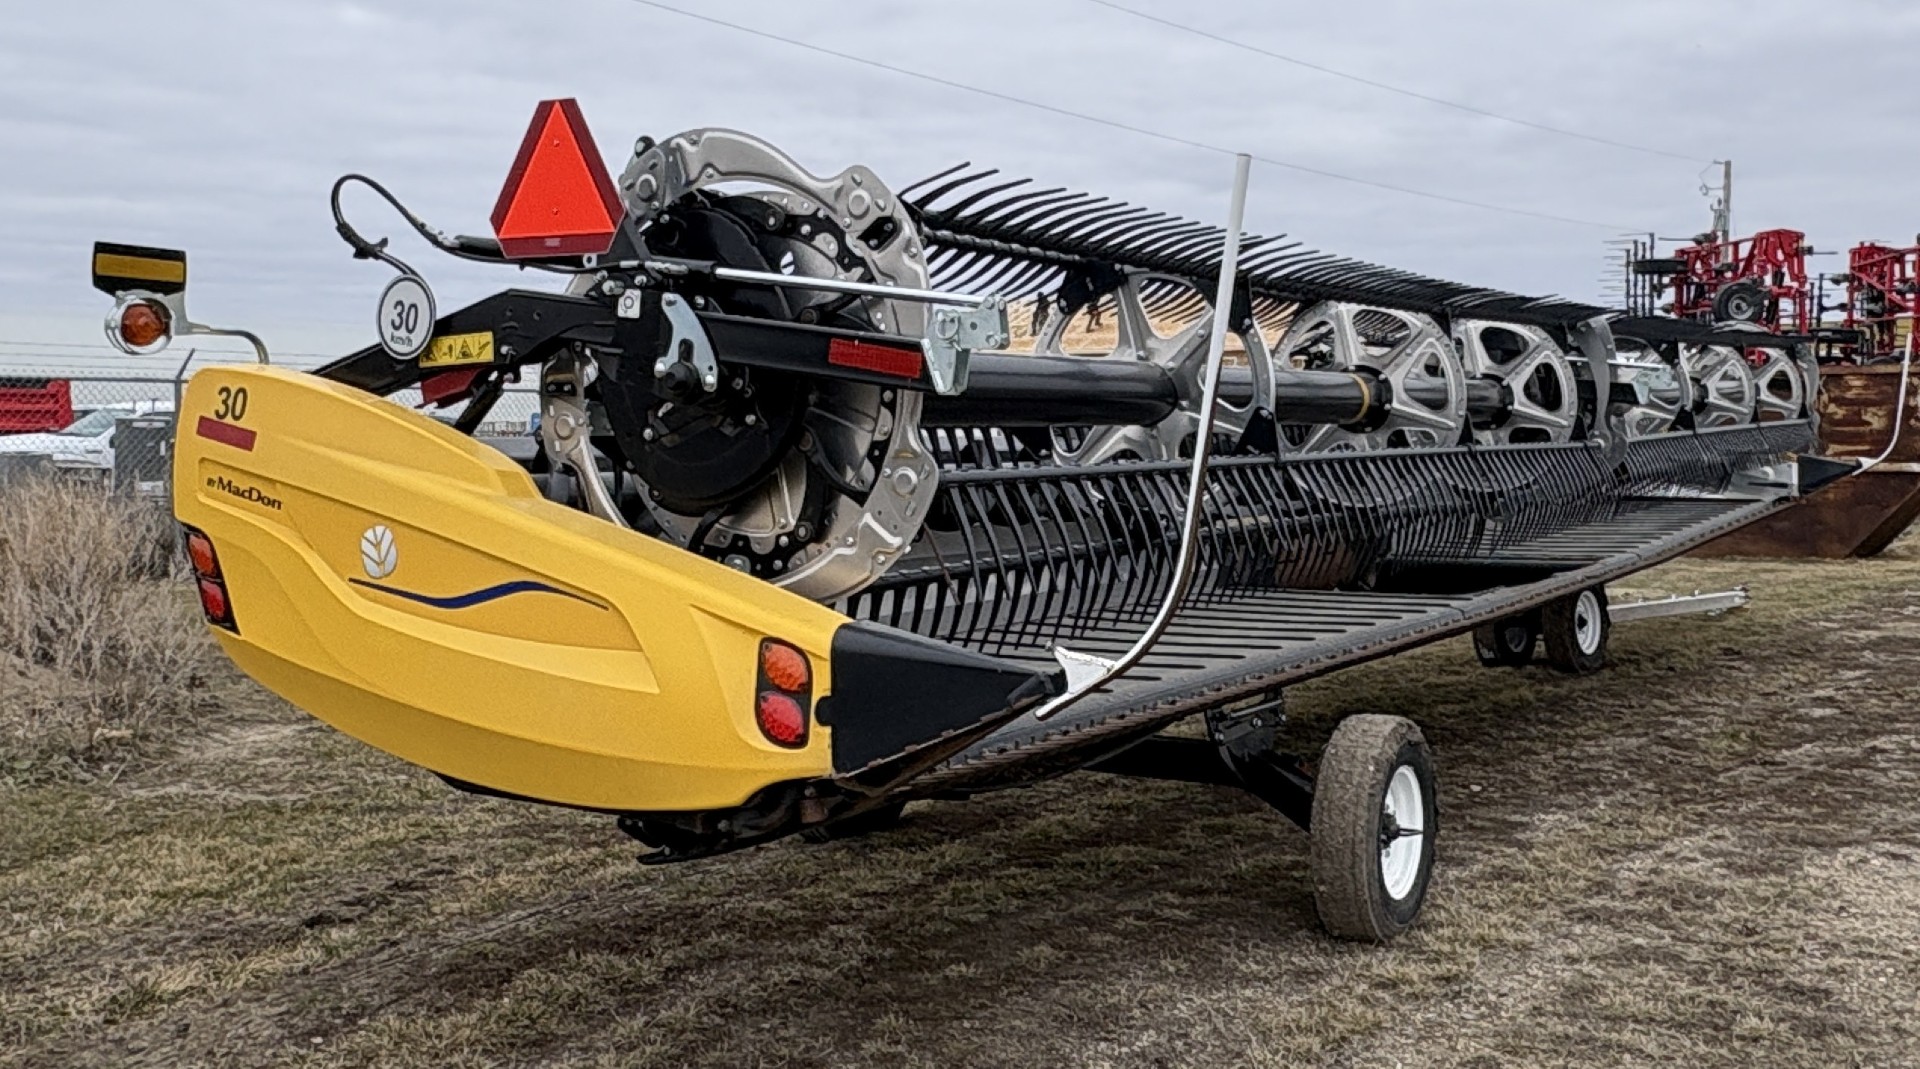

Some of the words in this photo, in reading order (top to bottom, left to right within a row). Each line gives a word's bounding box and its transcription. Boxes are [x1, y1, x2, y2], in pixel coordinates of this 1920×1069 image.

[391, 300, 418, 334] 30
[214, 386, 248, 421] 30
[217, 475, 282, 510] MacDon
